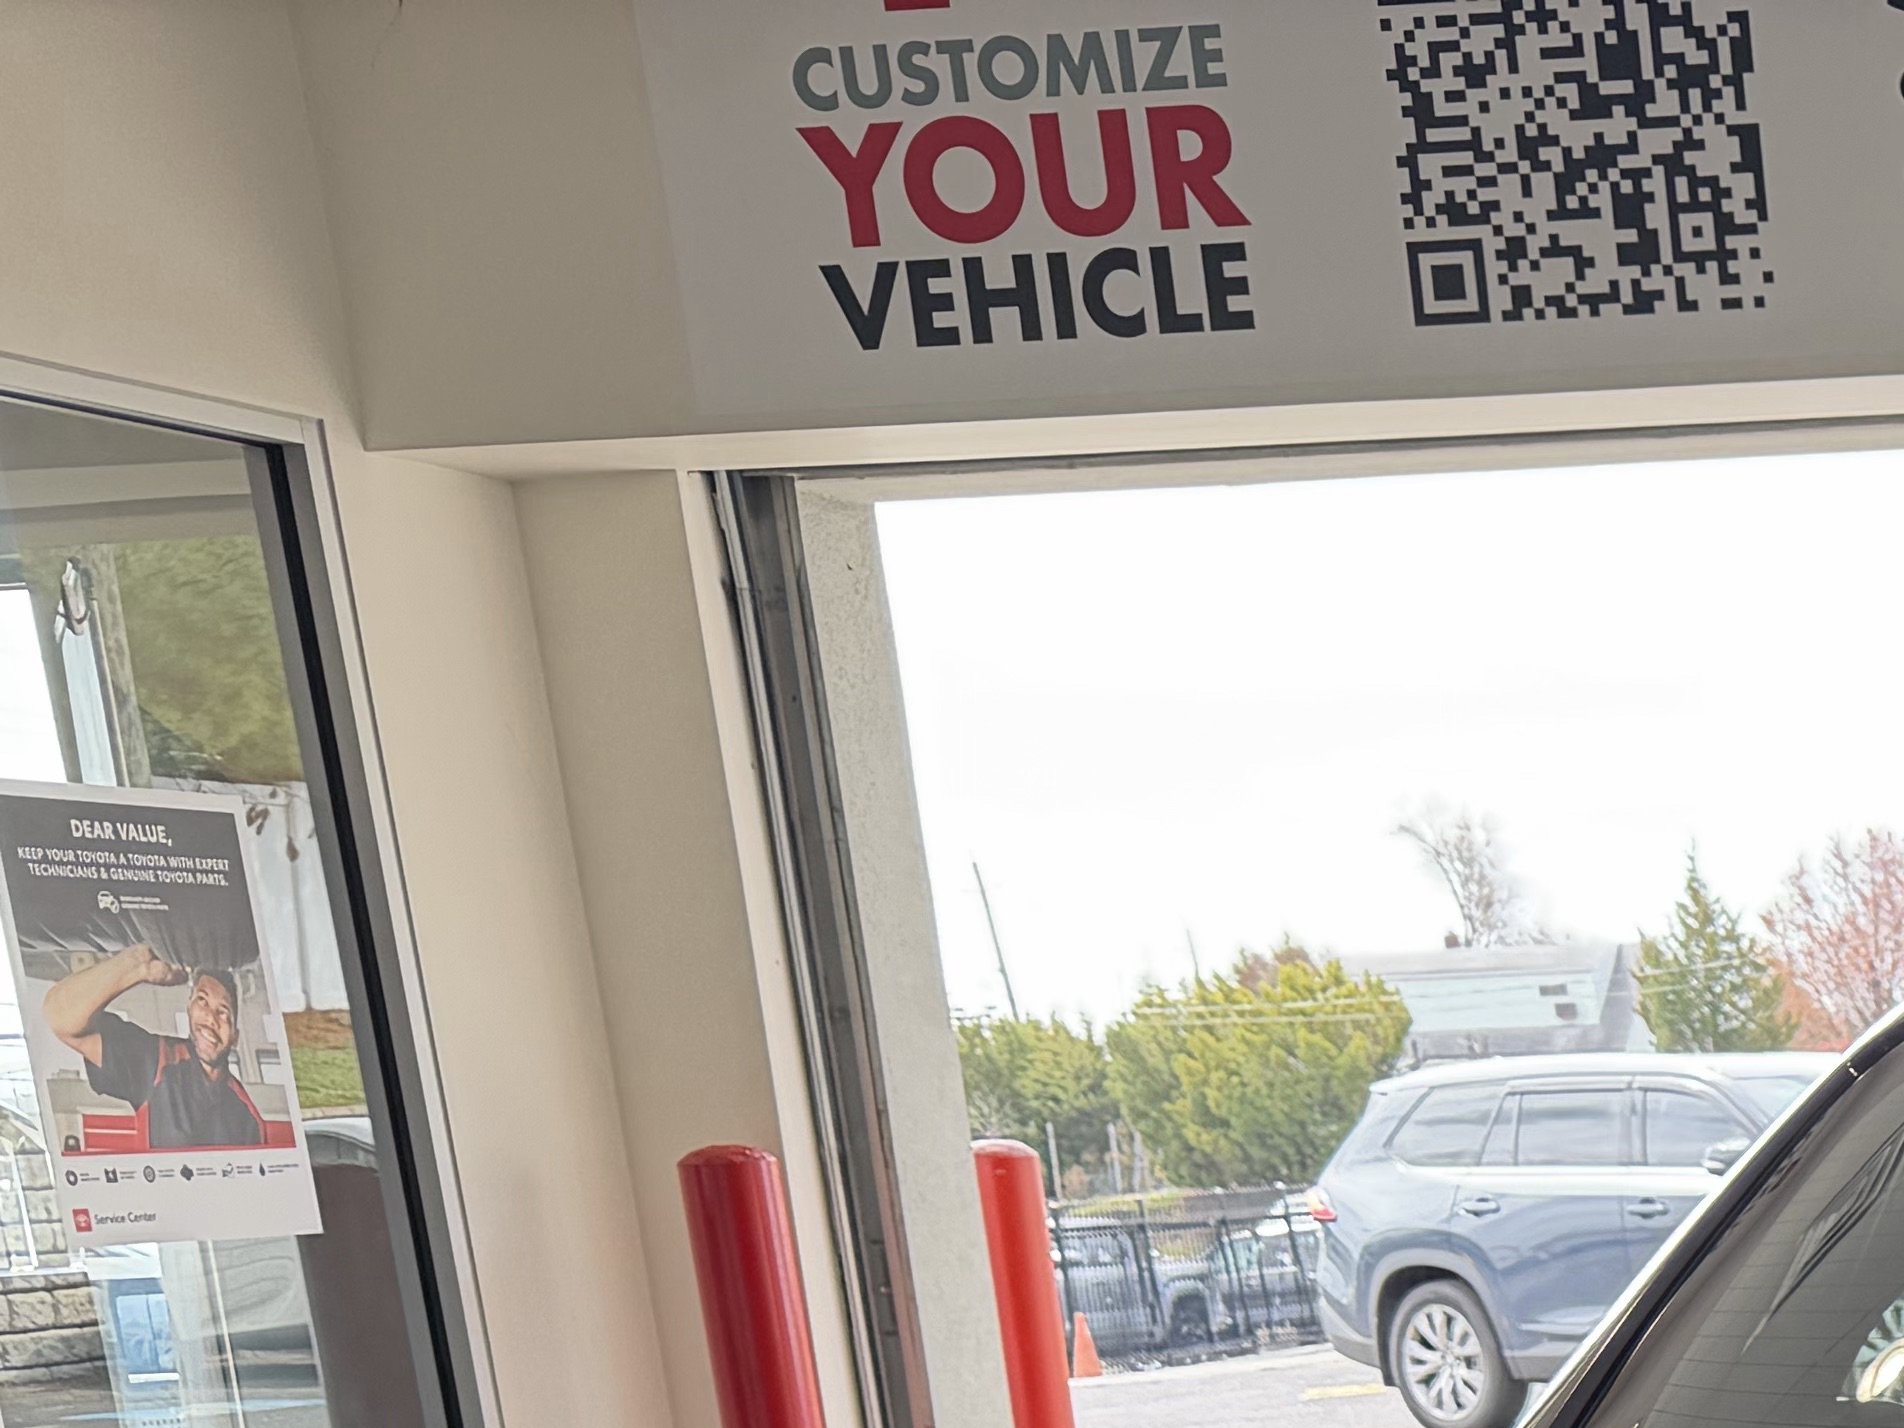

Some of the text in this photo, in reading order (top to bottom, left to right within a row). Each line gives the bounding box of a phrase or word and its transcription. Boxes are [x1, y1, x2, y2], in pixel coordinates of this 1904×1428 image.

[790, 24, 1230, 113] CUSTOMIZE
[795, 103, 1253, 249] YOUR
[818, 242, 1257, 351] VEHICLE
[70, 818, 173, 847] DEAR VALUE,
[17, 846, 230, 872] KEEP YOUR TOYOTA A TOYOTA WITH EXPERT
[27, 862, 98, 880] TECHNICIANS
[110, 867, 156, 882] GENUINE
[157, 870, 194, 885] TOYOTA
[94, 1210, 157, 1225] Service Center
